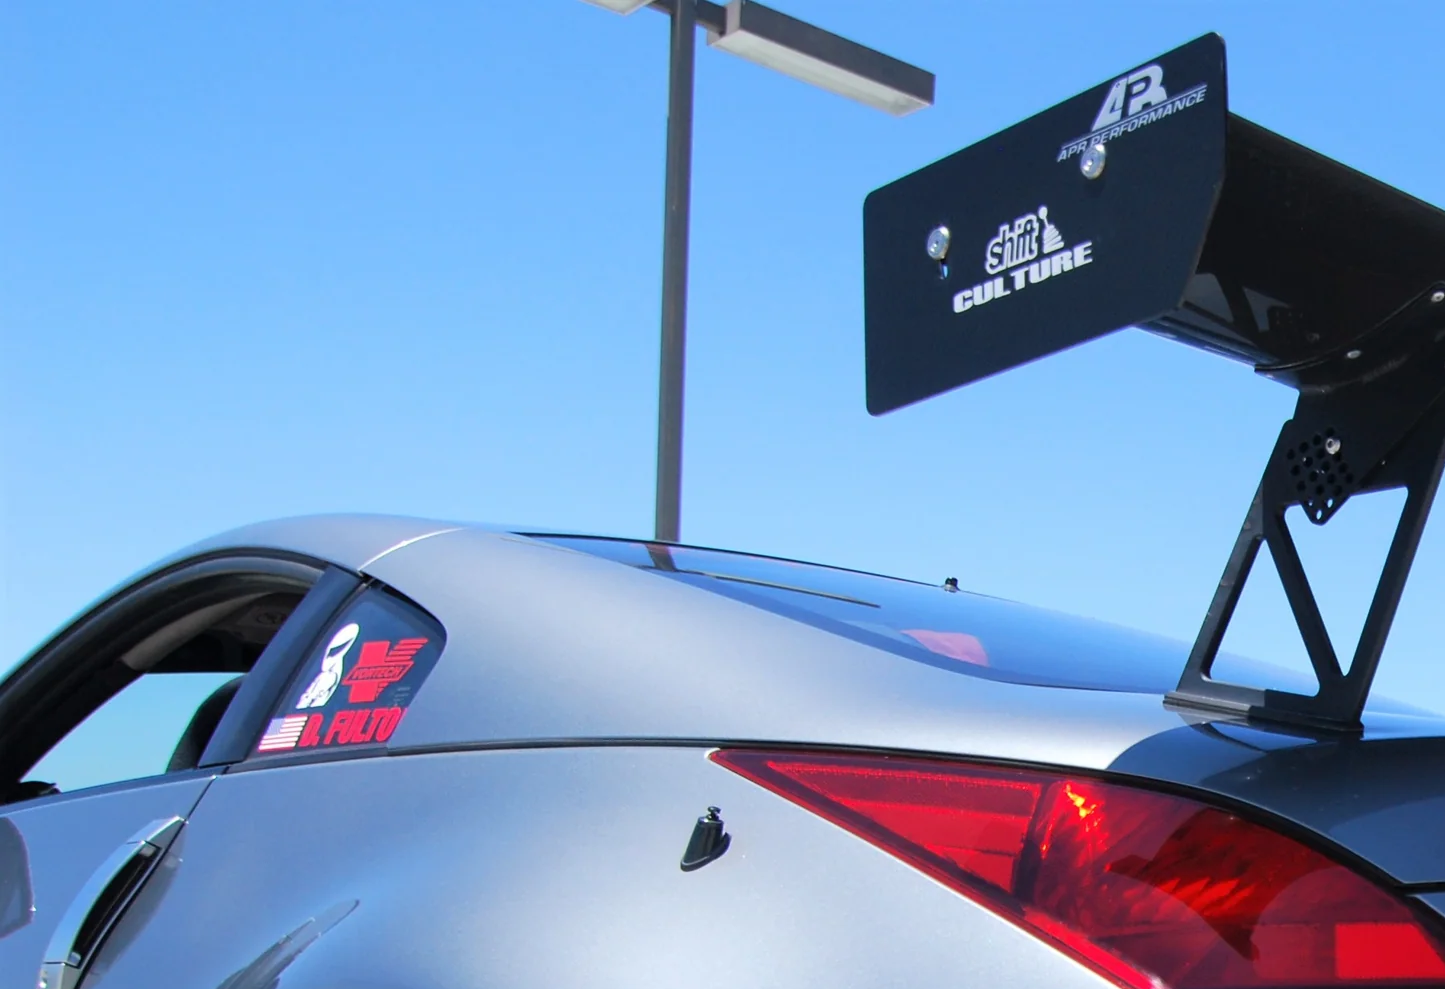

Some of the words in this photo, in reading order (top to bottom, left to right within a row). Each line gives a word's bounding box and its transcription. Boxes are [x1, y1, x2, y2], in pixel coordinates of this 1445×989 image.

[1057, 140, 1088, 163] APR
[1089, 88, 1208, 151] PERFORMANCE
[953, 241, 1093, 313] CULTURE
[323, 706, 407, 745] FULTO
